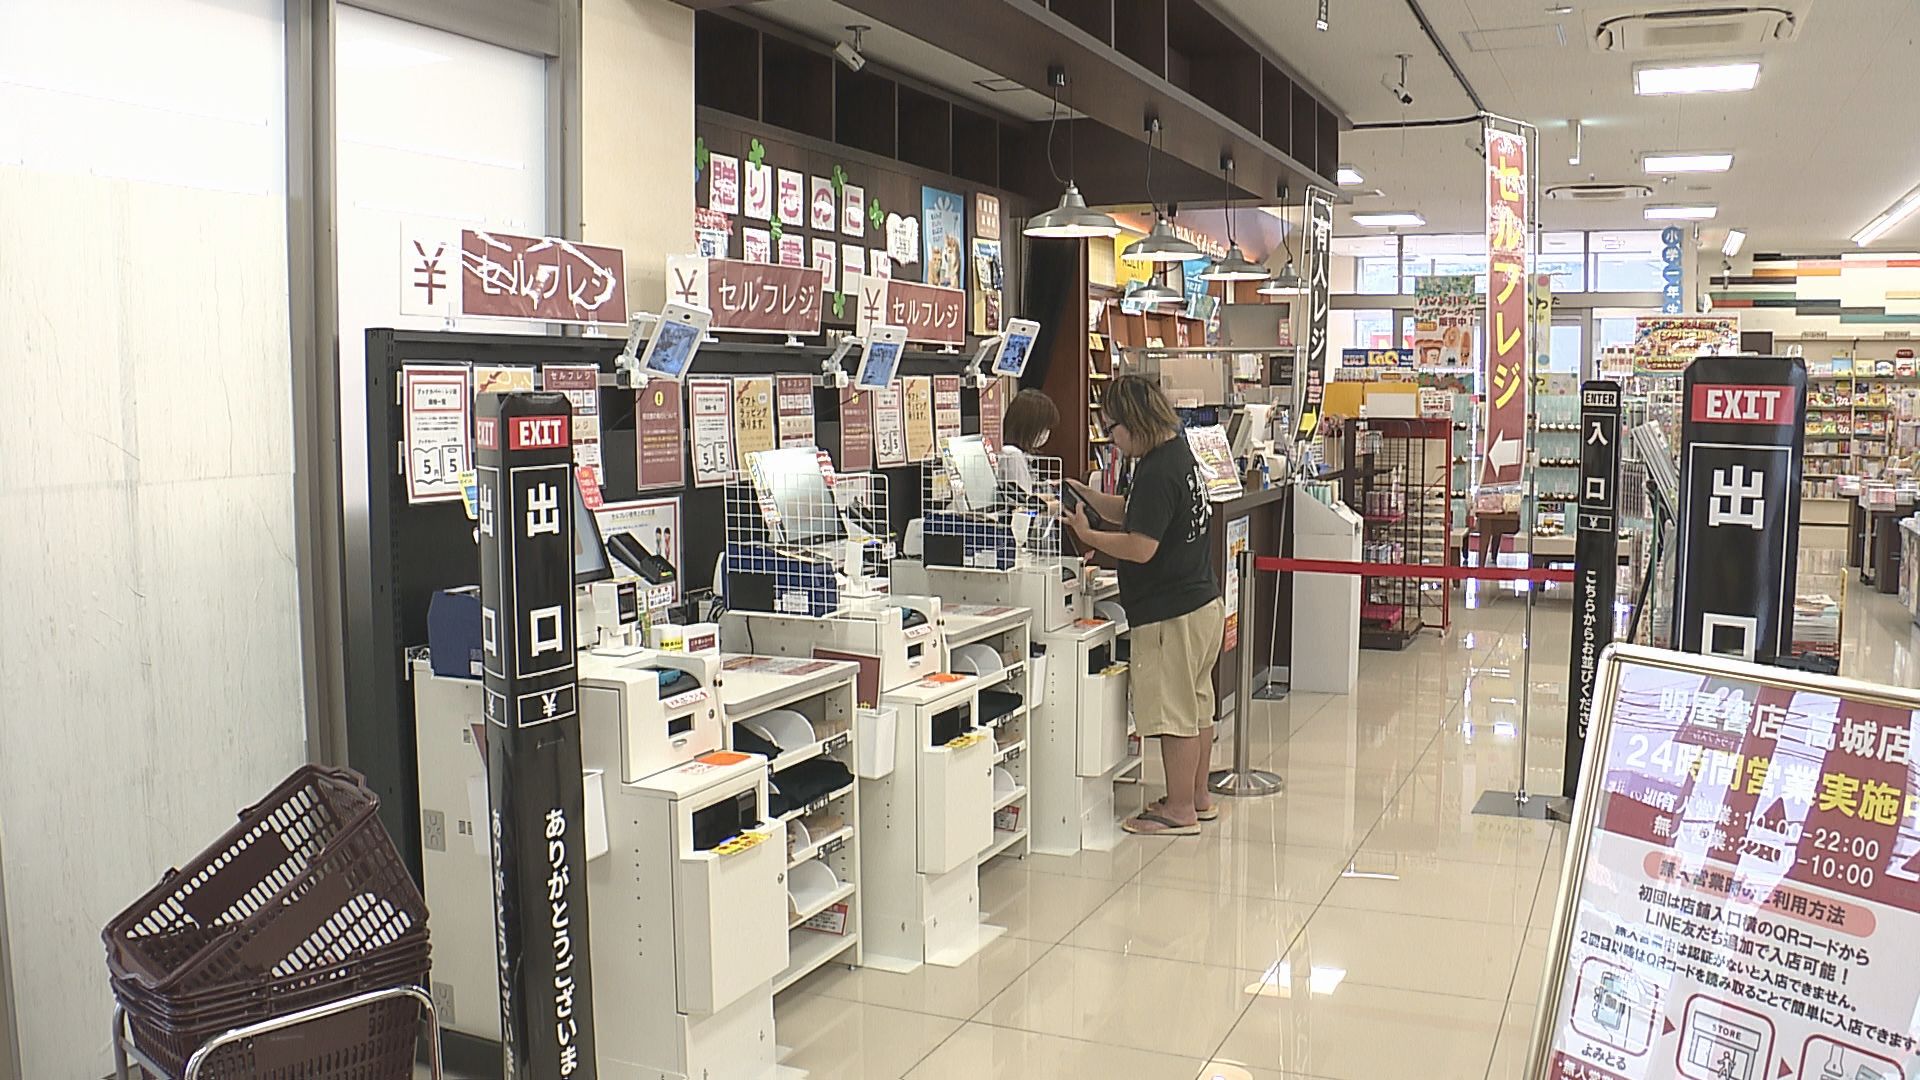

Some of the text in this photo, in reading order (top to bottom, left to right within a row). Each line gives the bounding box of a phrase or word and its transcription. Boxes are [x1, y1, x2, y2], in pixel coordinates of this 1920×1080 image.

[478, 254, 614, 303] セルフレジ
[718, 278, 816, 317] セルフレジ
[1311, 215, 1330, 361] 有人レジ
[1493, 155, 1521, 410] セルフレジ
[892, 299, 959, 329] セルフレジ
[550, 371, 591, 381] セルフレジ
[1584, 392, 1615, 405] ENTER
[1706, 389, 1781, 420] EXIT
[519, 419, 562, 446] EXIT
[1586, 421, 1608, 500] 入口
[527, 482, 563, 657] 出口
[1701, 464, 1766, 663] 出口
[544, 808, 578, 1080] ありがとうございま
[1638, 884, 1870, 967] 初回は店舗入口横のQRコードから
[1710, 1022, 1742, 1041] STORE
[1581, 1043, 1627, 1071] よみとる
